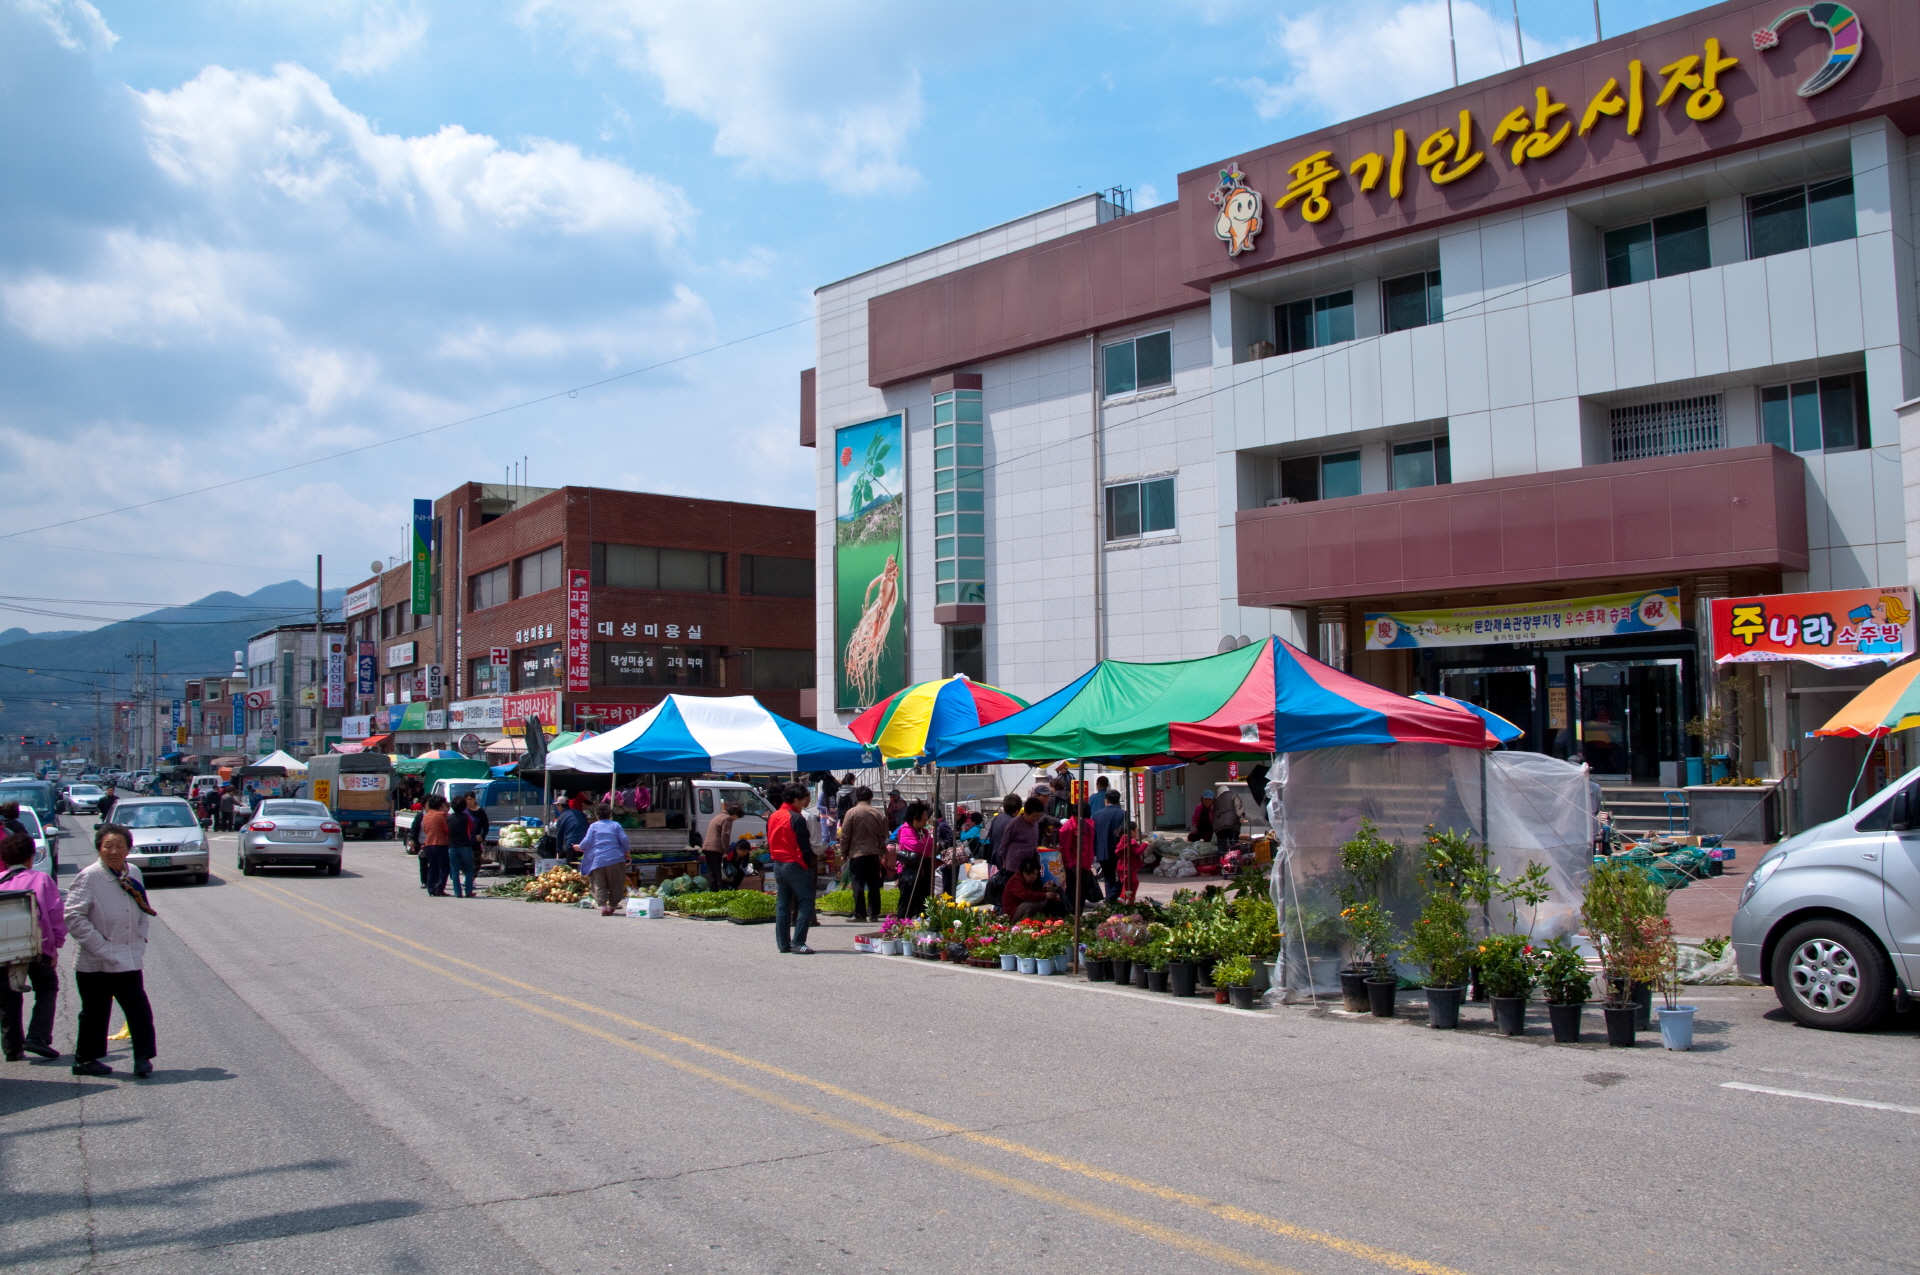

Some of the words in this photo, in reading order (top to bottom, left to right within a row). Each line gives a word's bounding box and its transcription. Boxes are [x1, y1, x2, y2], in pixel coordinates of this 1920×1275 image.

[1275, 37, 1739, 224] 풍기인삼시장
[414, 514, 431, 522] NH
[597, 621, 702, 640] 대성미용실
[1474, 612, 1562, 634] 문화체육관광부지정
[1564, 606, 1606, 627] 우수축제
[1609, 605, 1632, 624] 승격
[1731, 602, 1836, 648] 주나라
[1837, 622, 1901, 647] 소주방
[516, 622, 553, 644] 대성미용실
[570, 590, 580, 678] 고려인삼사
[580, 590, 589, 678] 고려삼영농조합
[1493, 632, 1537, 642] 풍기인삼시장
[611, 655, 654, 667] 대성미용실
[667, 657, 683, 668] 고대
[510, 696, 550, 723] 고려인삼사
[350, 776, 361, 788] 생강
[362, 777, 380, 788] 도너츠
